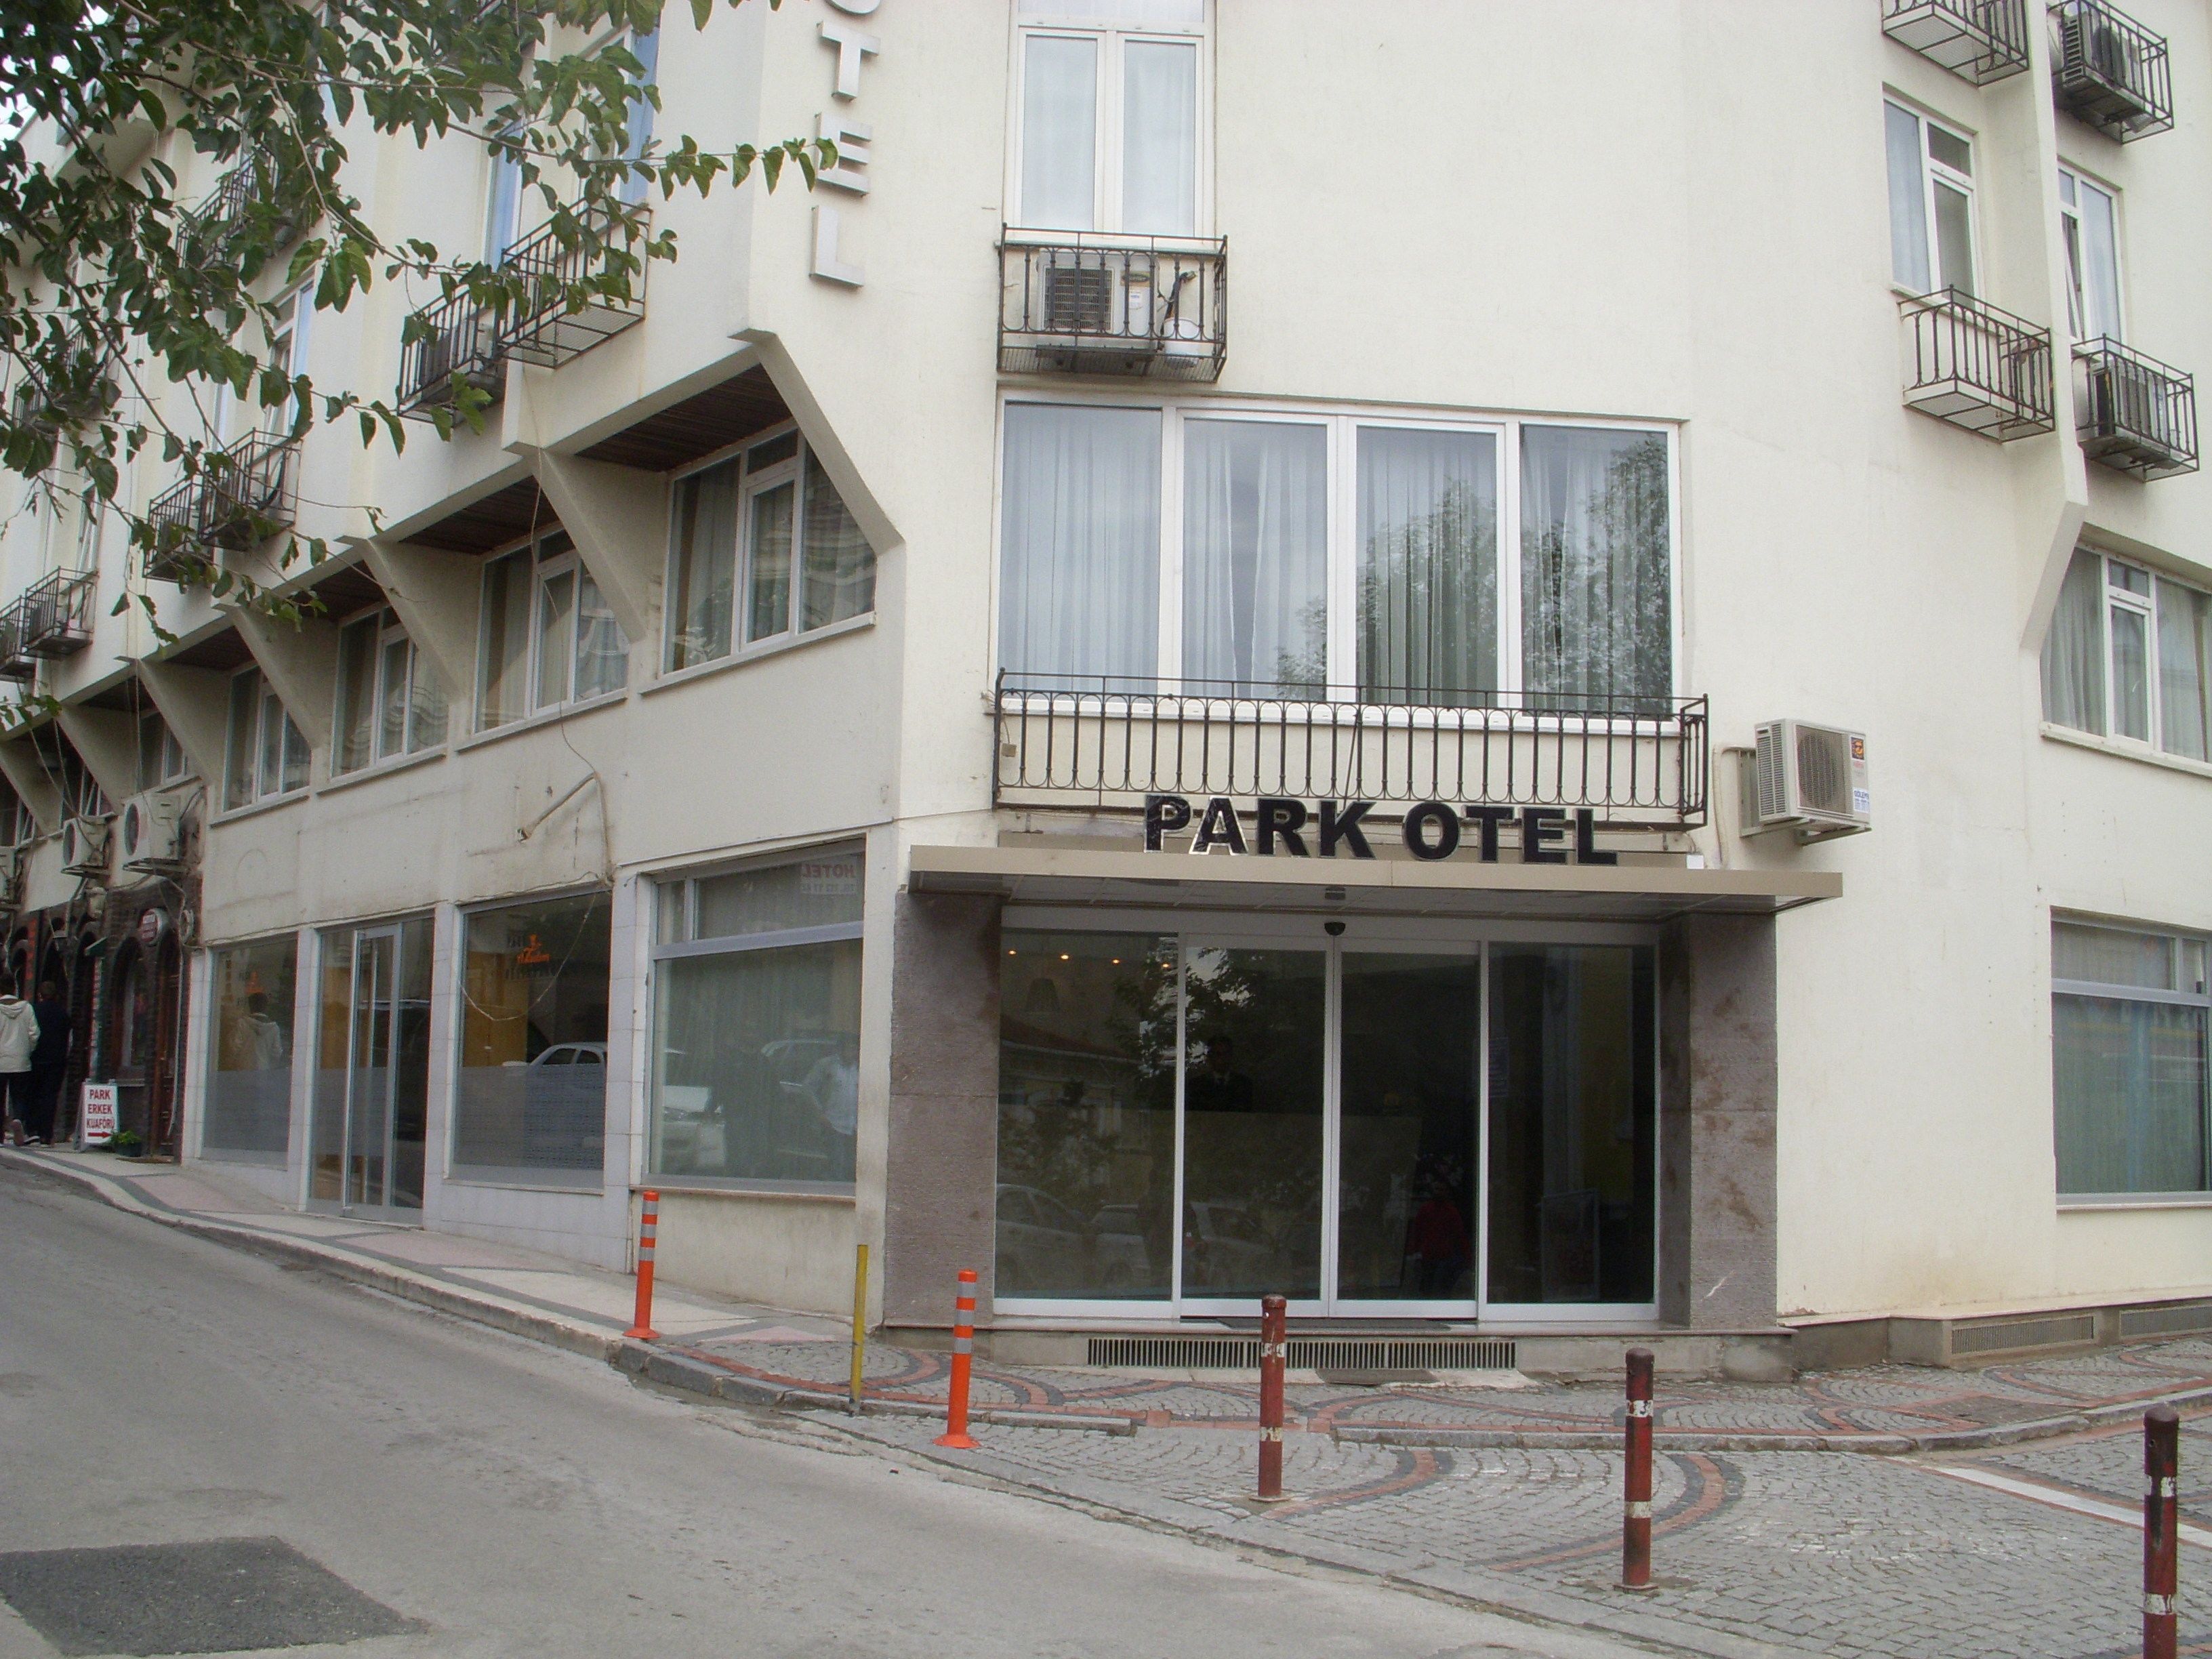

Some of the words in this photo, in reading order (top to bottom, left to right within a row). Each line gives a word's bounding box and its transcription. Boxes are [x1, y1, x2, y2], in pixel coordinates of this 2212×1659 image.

[809, 0, 881, 288] TEL
[1143, 794, 1376, 859] PARK
[1401, 801, 1618, 866] OTEL
[88, 1104, 112, 1114] ERKEK
[89, 1089, 110, 1099] PARK
